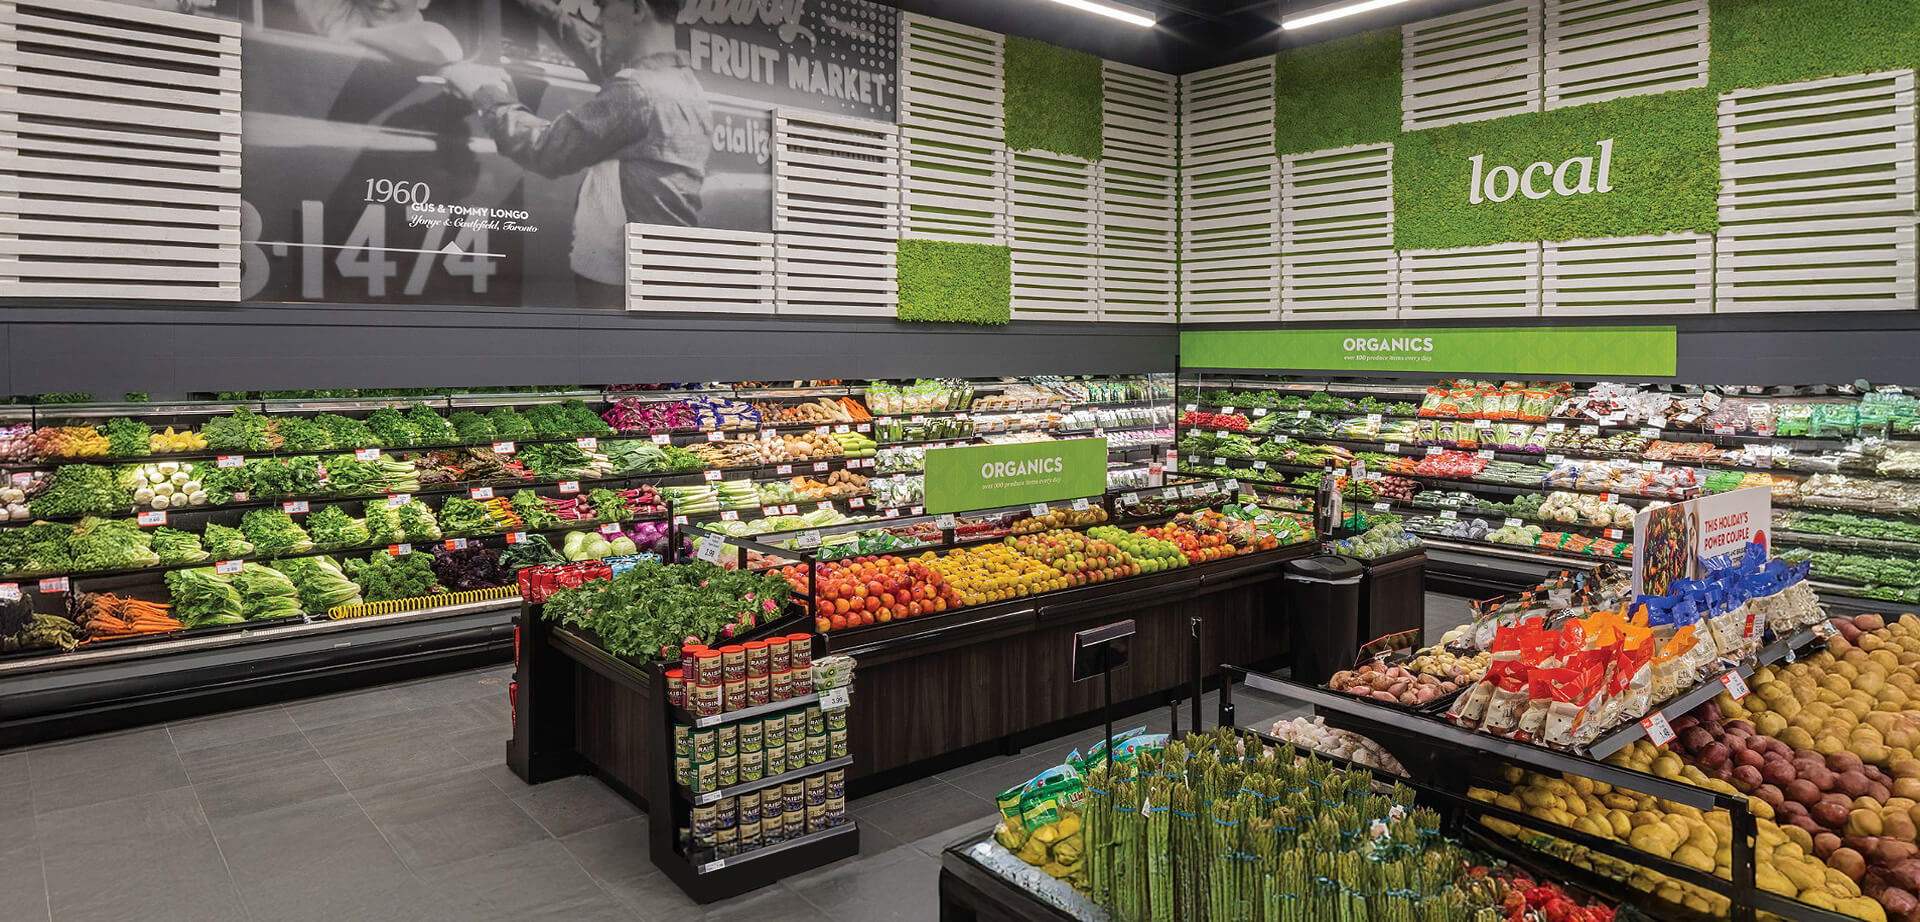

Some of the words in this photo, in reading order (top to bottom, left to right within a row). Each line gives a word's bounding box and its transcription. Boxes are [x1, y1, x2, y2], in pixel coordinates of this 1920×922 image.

[689, 28, 780, 86] FRUIT
[787, 53, 887, 106] MARKET
[712, 115, 772, 165] cializ
[1468, 138, 1613, 205] local
[364, 178, 431, 205] 1960
[411, 202, 436, 213] GUS
[437, 203, 446, 213] &
[447, 204, 489, 217] TOMMY
[490, 208, 529, 220] LONGO
[408, 214, 442, 229] Yonge
[442, 218, 453, 227] &
[502, 221, 538, 233] Toronto
[1343, 337, 1433, 351] ORGANICS
[981, 456, 1063, 479] ORGANICS
[1705, 519, 1718, 533] THIS
[1719, 512, 1748, 529] HOLIDAY'S
[1704, 533, 1725, 551] POWER
[1727, 528, 1749, 543] COUPLE
